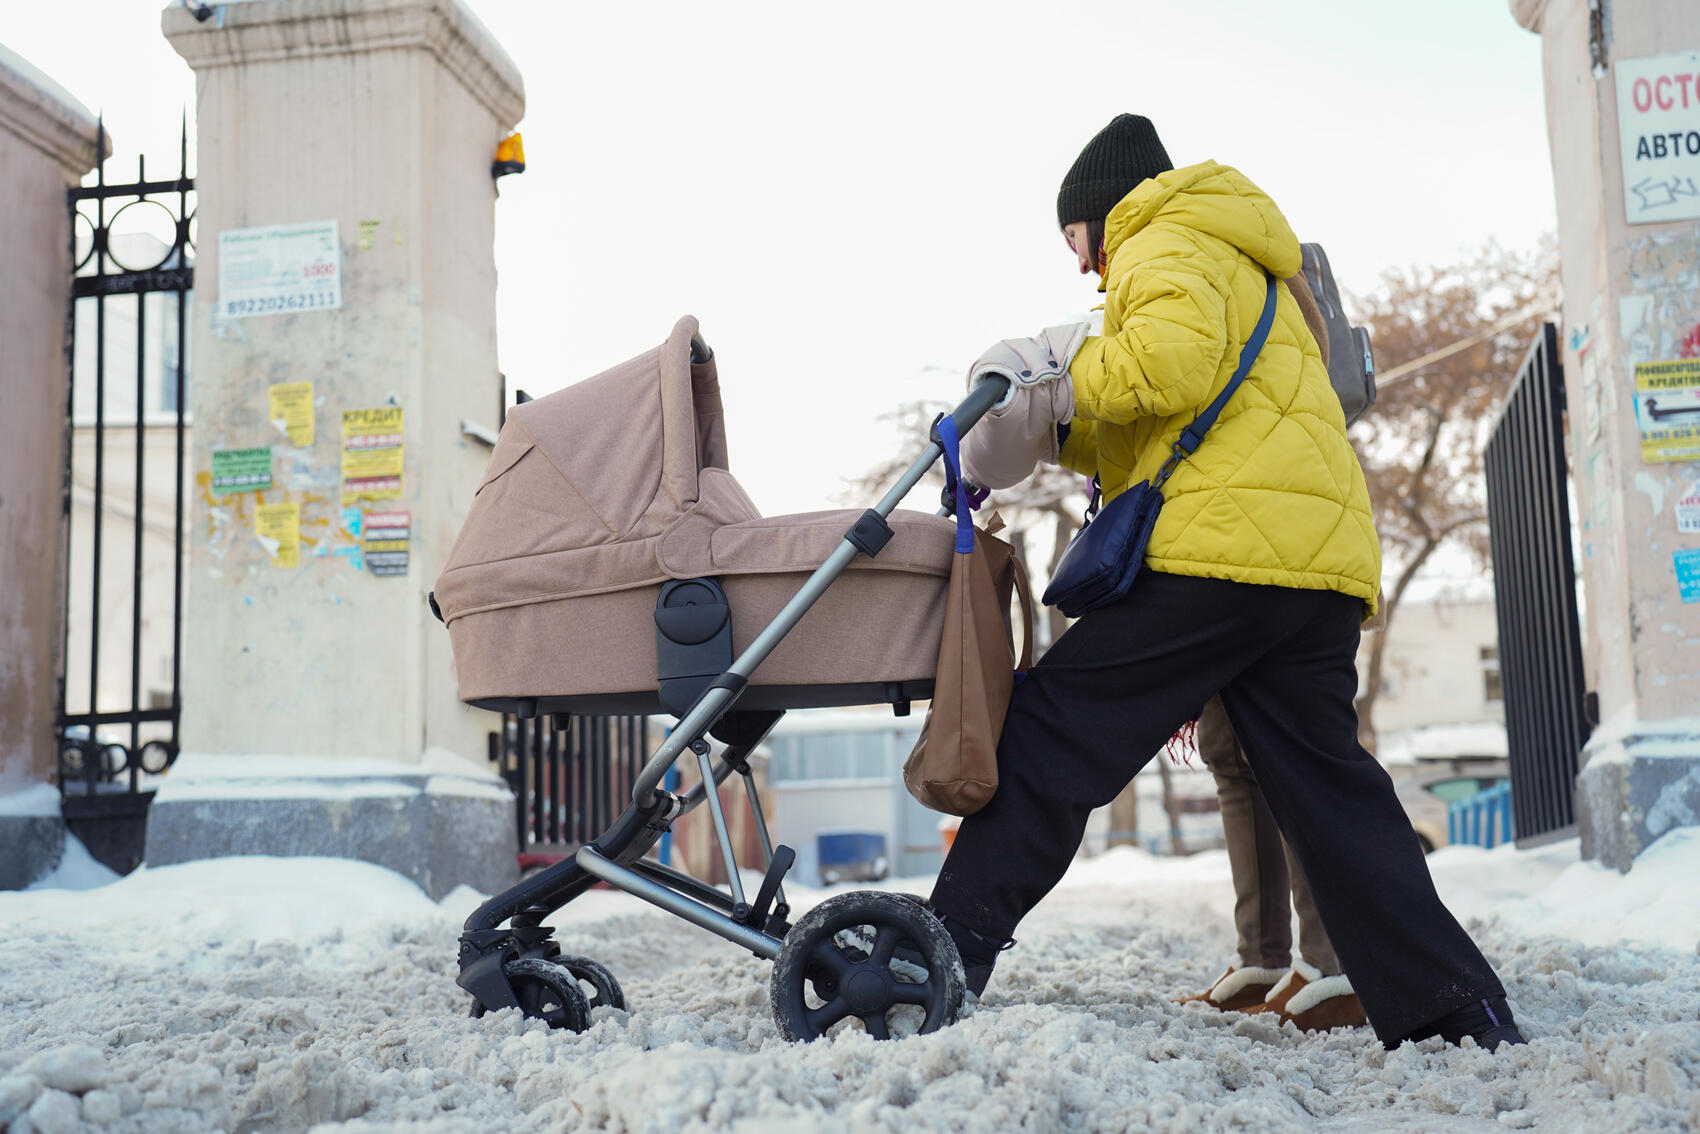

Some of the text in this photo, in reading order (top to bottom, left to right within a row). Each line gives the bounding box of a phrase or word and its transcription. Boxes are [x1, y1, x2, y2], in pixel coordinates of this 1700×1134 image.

[1633, 72, 1700, 113] ОСТ
[1636, 131, 1700, 161] АВТО
[343, 408, 402, 424] КРЕДИТ
